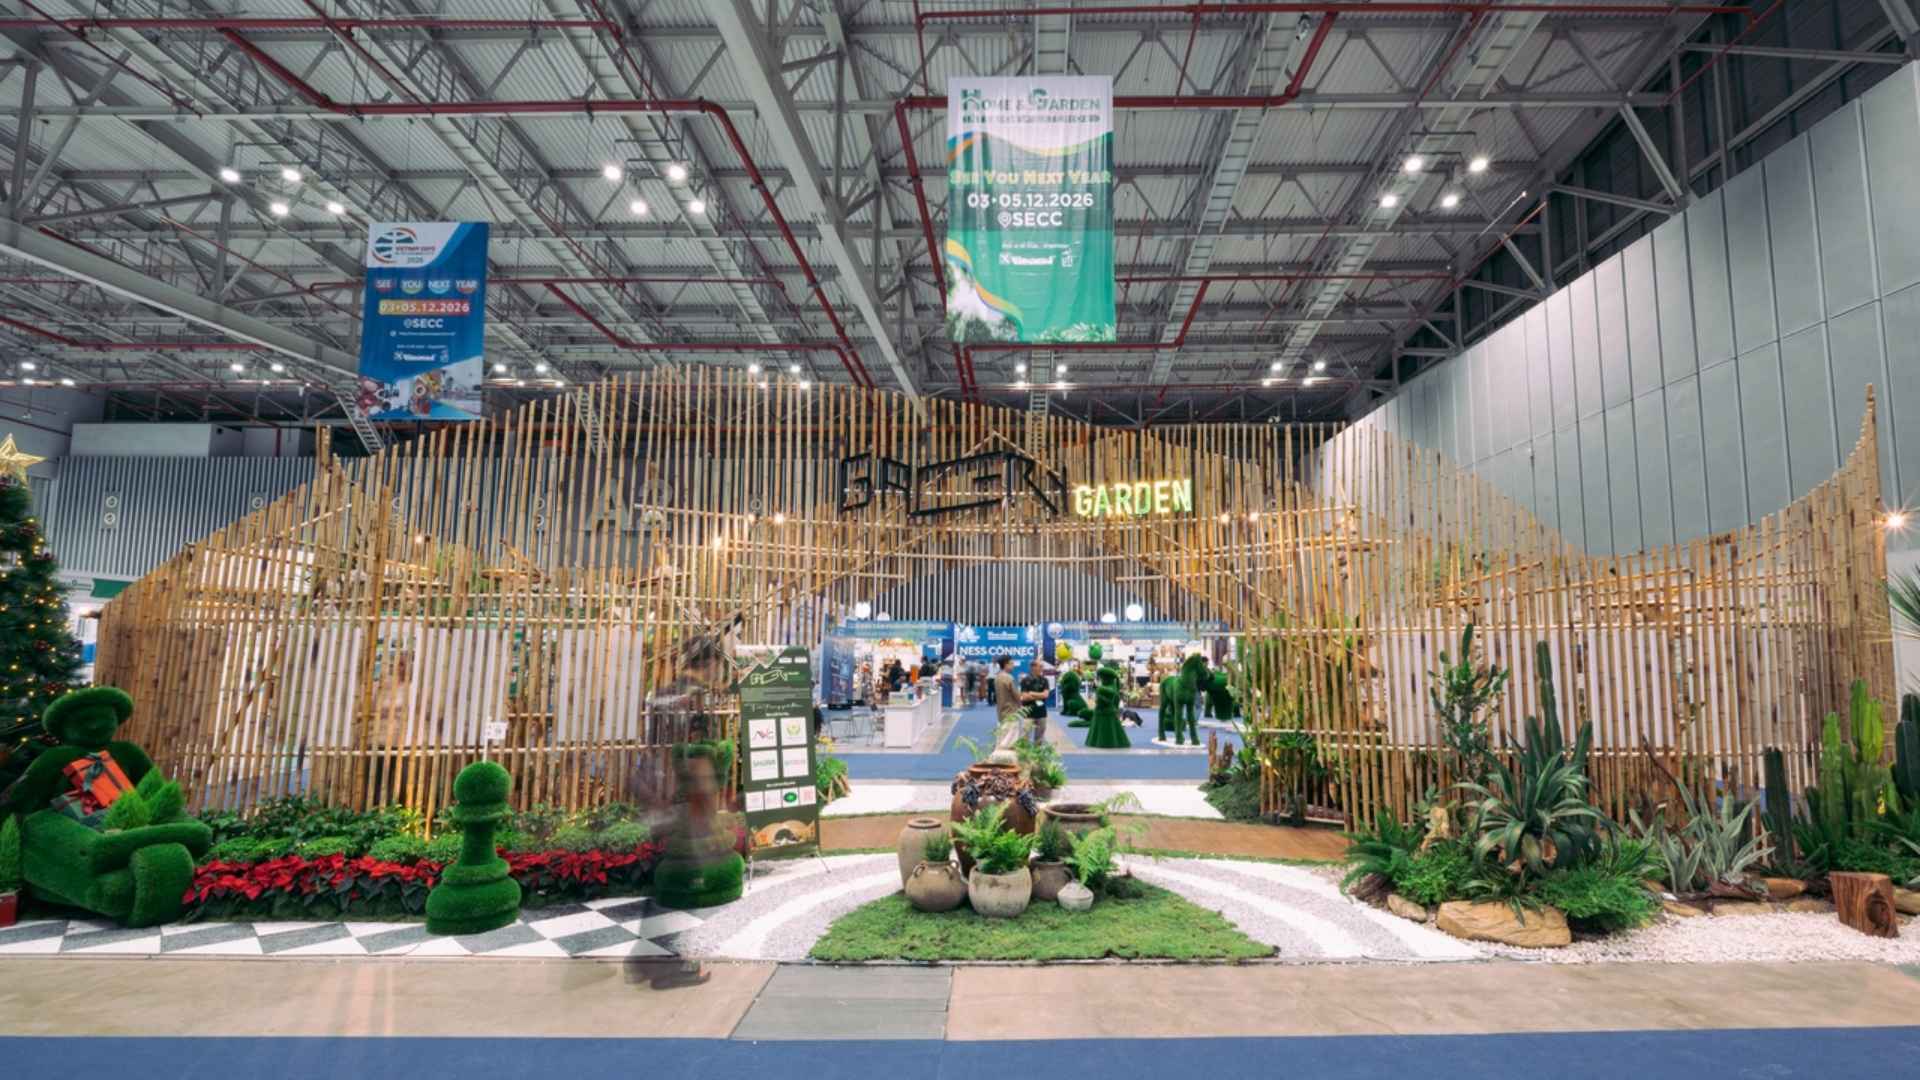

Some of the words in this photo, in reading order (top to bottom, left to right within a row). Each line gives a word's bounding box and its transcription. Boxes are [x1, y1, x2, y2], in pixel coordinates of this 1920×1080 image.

[402, 279, 422, 289] YOU
[428, 279, 450, 289] NEXT
[456, 279, 478, 289] YEAR
[1074, 478, 1194, 518] GARDEN
